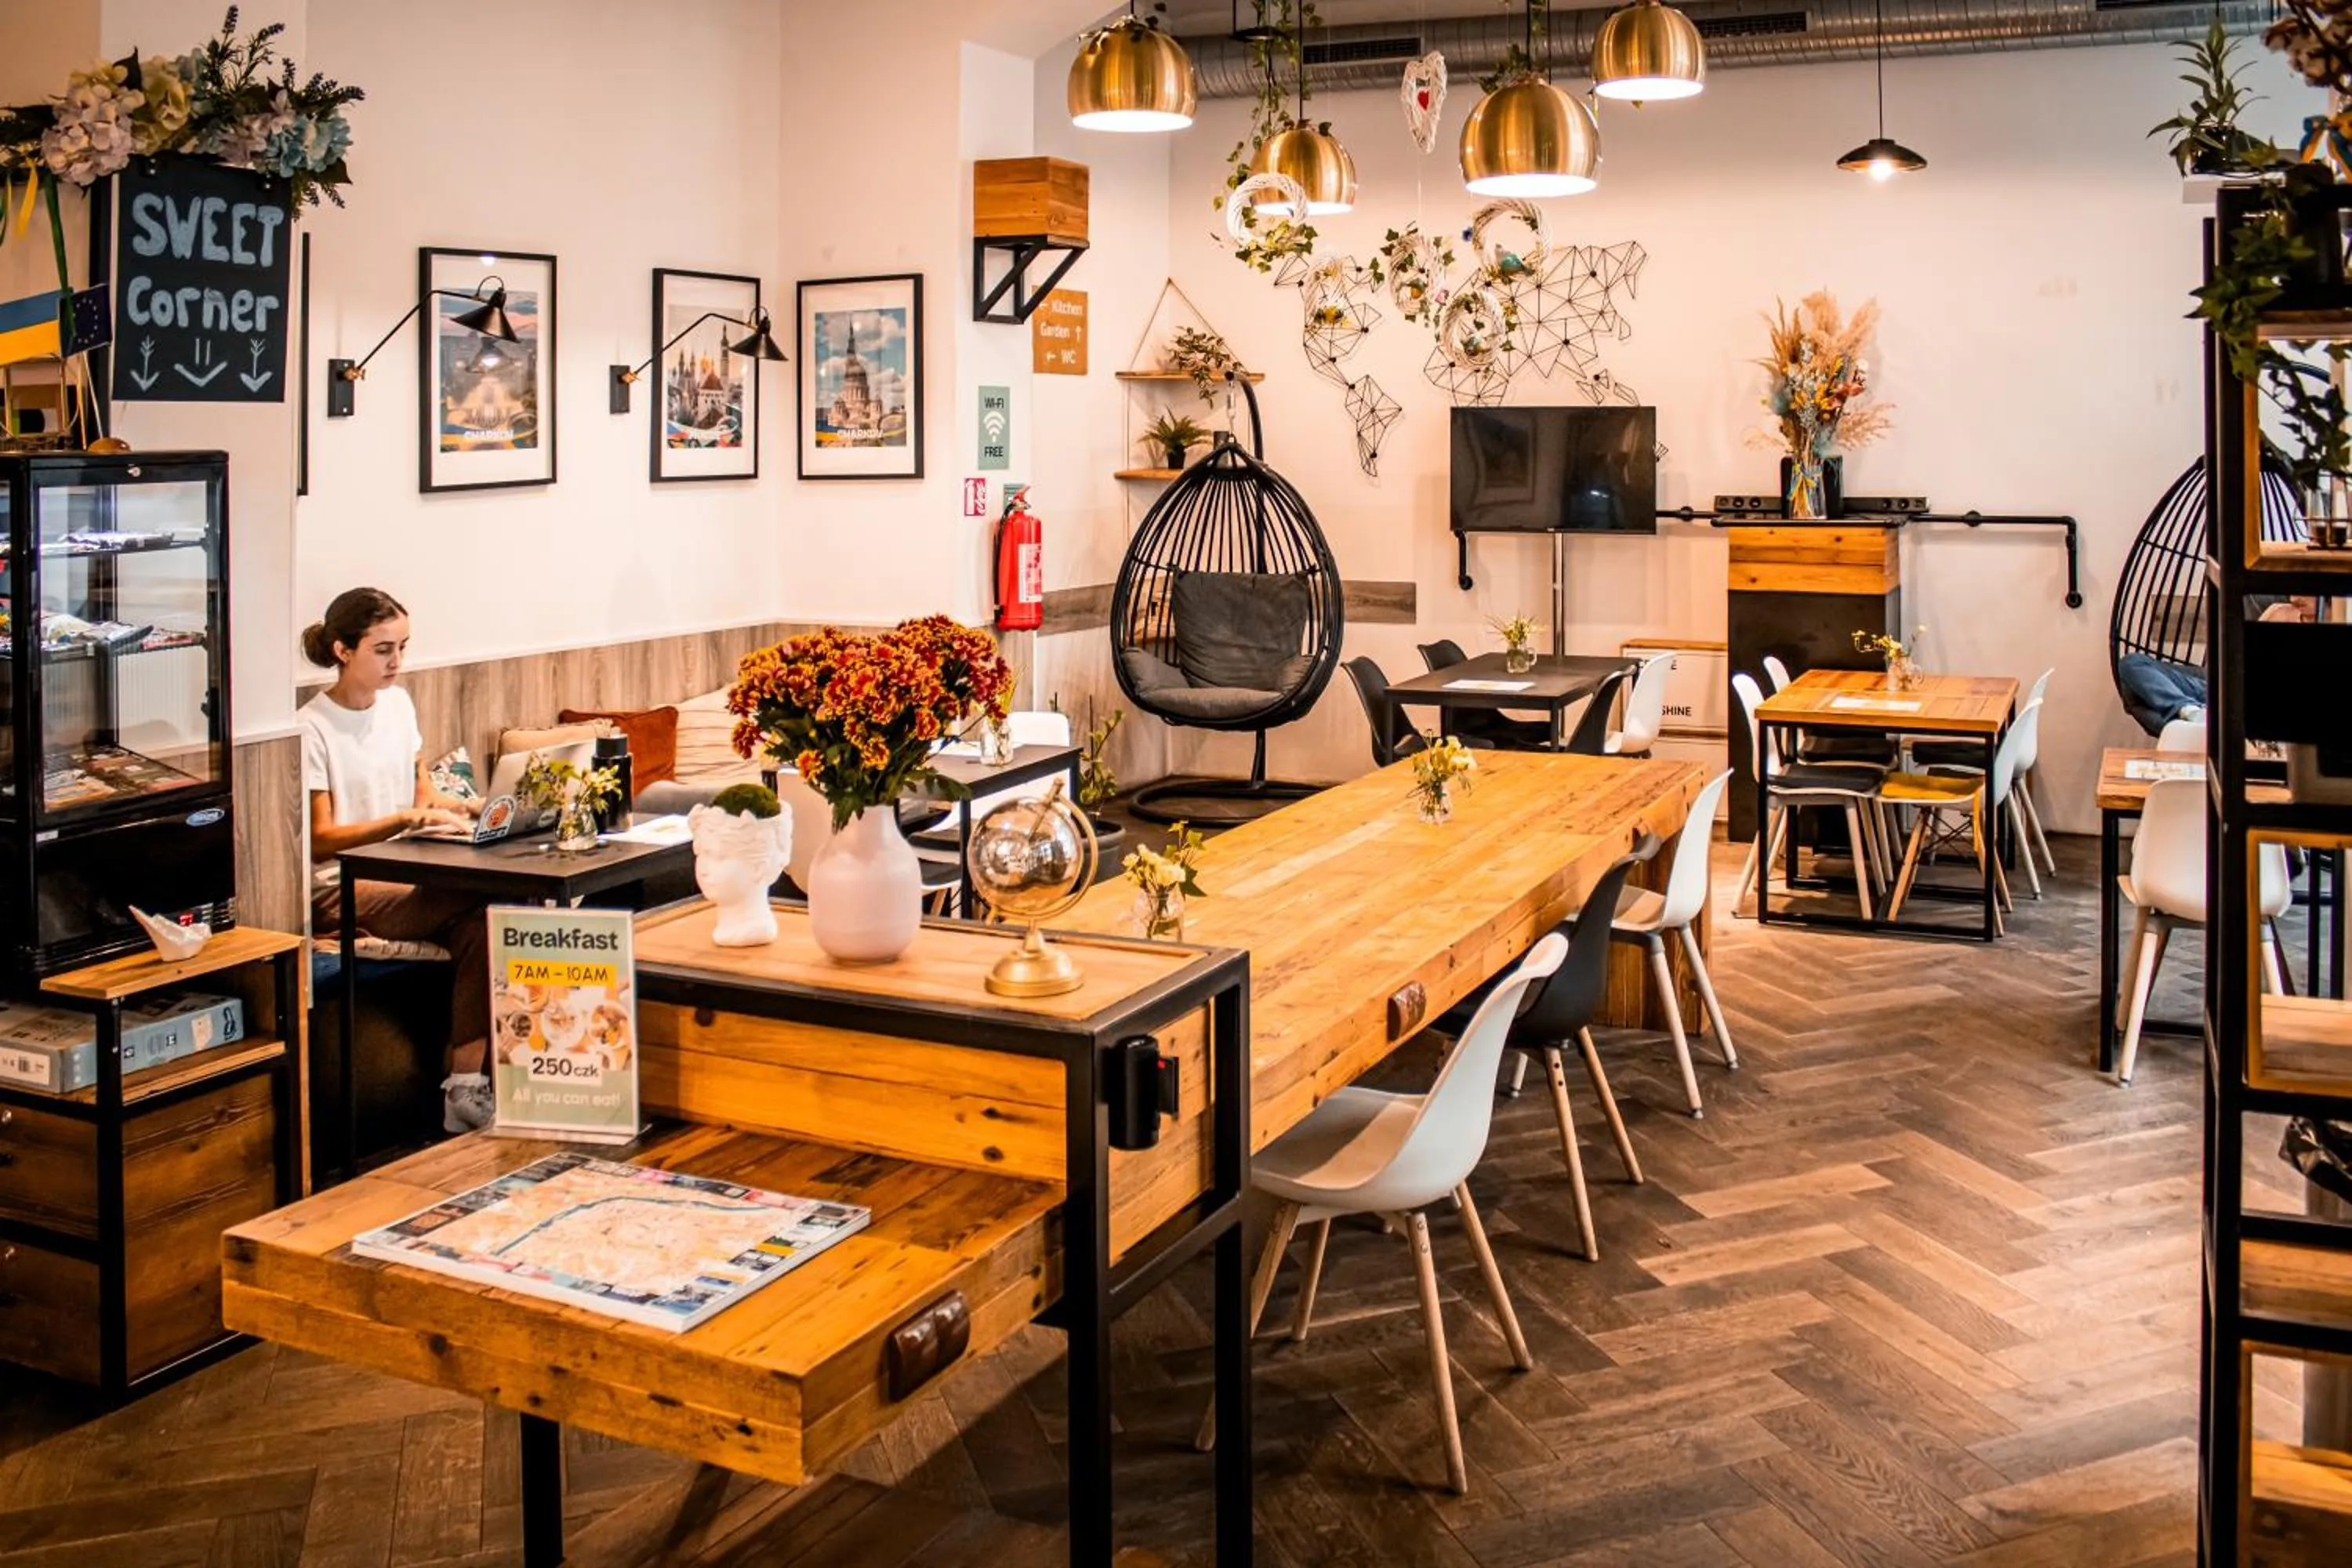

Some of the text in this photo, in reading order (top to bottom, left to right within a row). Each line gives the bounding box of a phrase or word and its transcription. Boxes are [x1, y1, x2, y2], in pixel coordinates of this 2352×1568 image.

[132, 192, 284, 267] SWEET
[127, 276, 279, 332] Corner
[1051, 299, 1083, 316] Kitchen
[1040, 321, 1070, 338] Garden
[1061, 350, 1076, 364] WC
[984, 397, 1004, 408] WI-FI
[984, 446, 1004, 457] FREE
[503, 927, 619, 950] Breakfast
[514, 965, 550, 979] 7AM
[567, 967, 609, 982] 10AM
[512, 1087, 531, 1103] All
[535, 1091, 561, 1105] you
[564, 1093, 589, 1105] can
